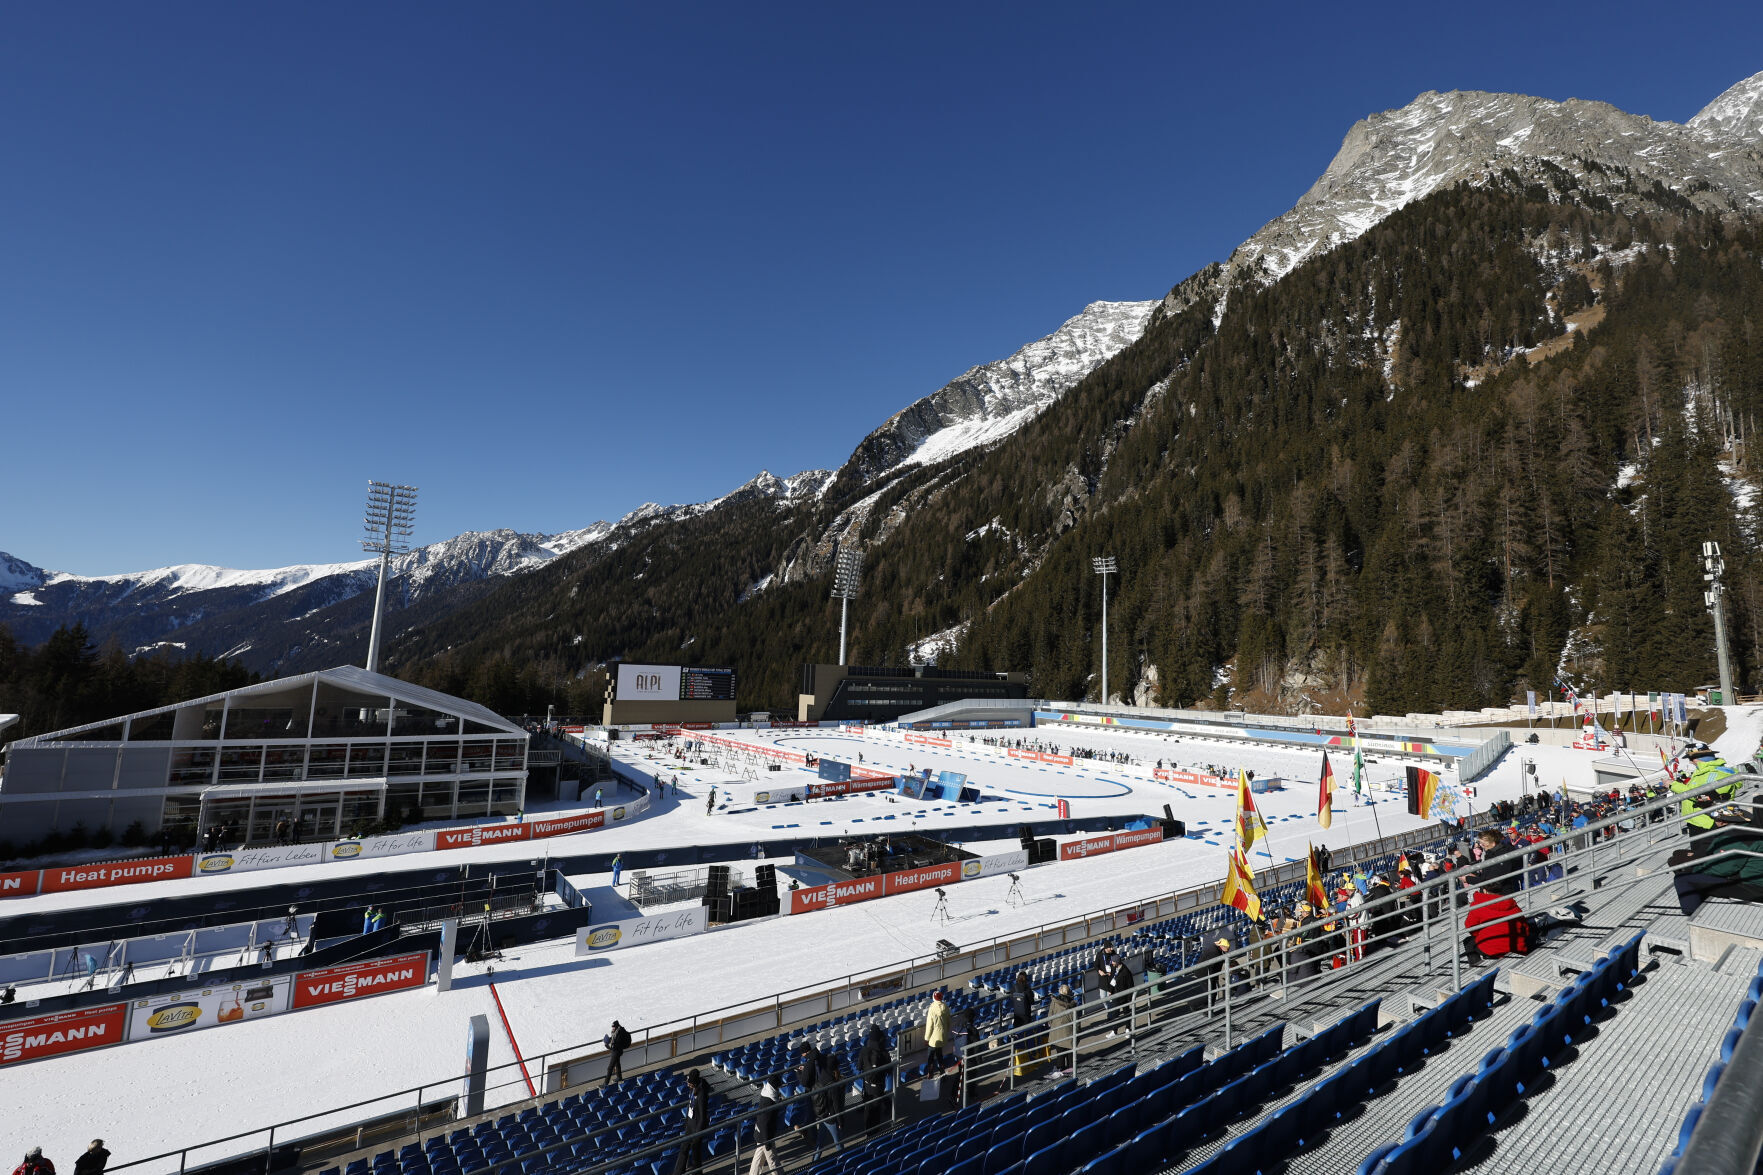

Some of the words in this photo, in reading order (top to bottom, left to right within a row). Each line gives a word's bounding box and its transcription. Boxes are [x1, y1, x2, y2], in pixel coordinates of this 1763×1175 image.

[1202, 776, 1238, 787] VIESSMAN
[535, 815, 603, 833] Wärmepumpen
[371, 840, 388, 851] Fit
[389, 840, 405, 851] for
[407, 836, 424, 847] life
[445, 827, 522, 846] VIESSMANN
[1116, 831, 1161, 845] Wärmepumpen
[238, 855, 257, 866] Fit
[256, 852, 280, 867] fürs
[285, 848, 318, 861] Leben
[1066, 840, 1110, 857] VIESSMANN
[61, 869, 107, 884] Heat
[110, 863, 174, 881] pumps
[895, 874, 918, 887] Heat
[919, 868, 952, 884] pumps
[0, 877, 21, 890] N
[801, 882, 875, 906] VIESSMANN
[633, 922, 651, 937] Fit
[653, 919, 668, 936] for
[674, 913, 694, 928] life
[308, 969, 413, 996] VIESSMANN
[43, 1013, 77, 1022] VIESSMANN
[0, 1024, 106, 1061] SSMANN
[904, 1033, 912, 1052] H
